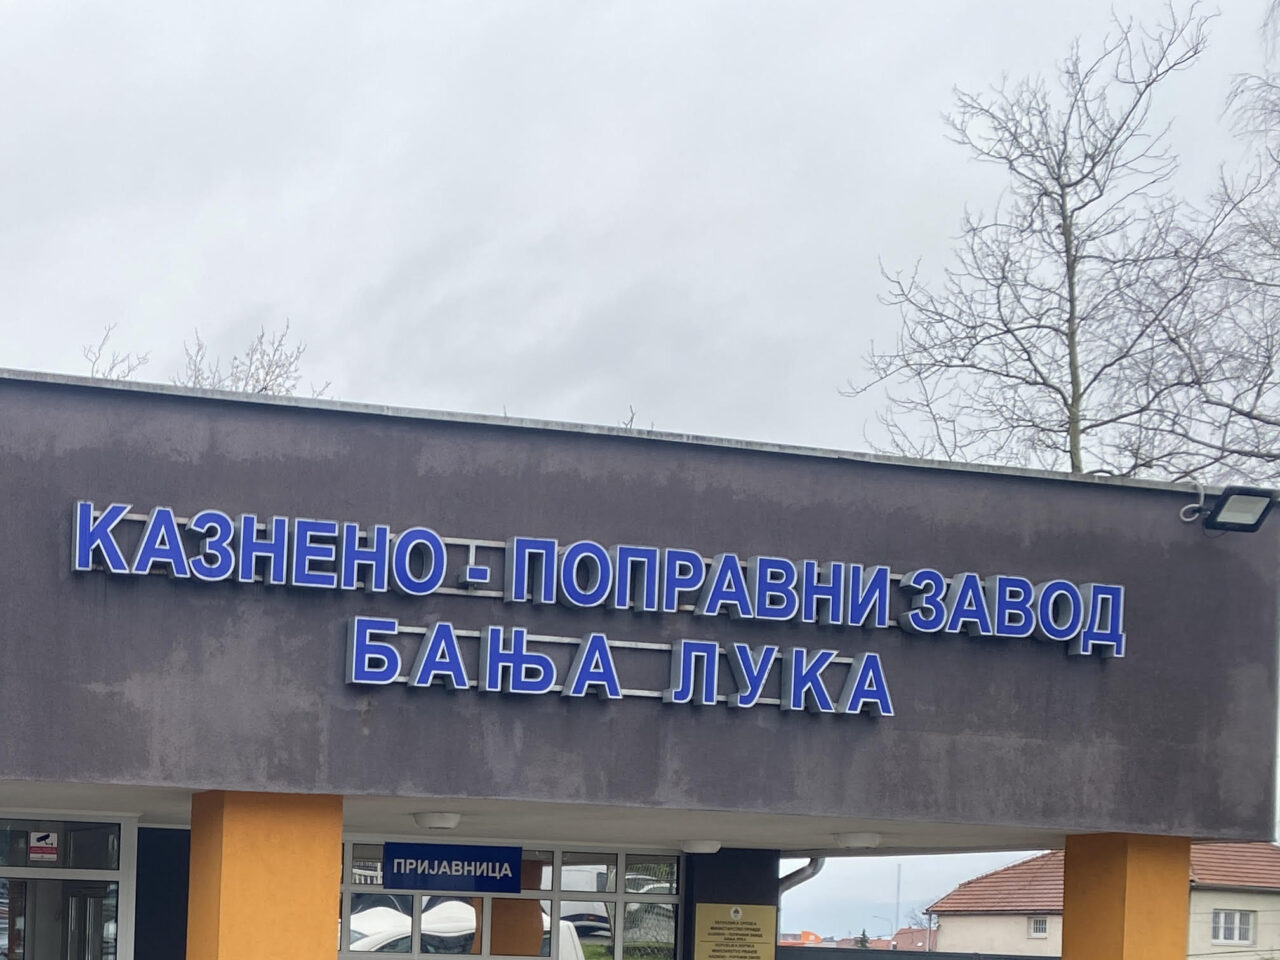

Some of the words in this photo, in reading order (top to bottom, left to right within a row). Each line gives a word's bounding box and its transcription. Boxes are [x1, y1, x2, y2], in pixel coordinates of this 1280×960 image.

[73, 500, 447, 596] КАЗНЕНО
[466, 565, 490, 583] -
[507, 536, 891, 628] ПОПРАВНИ
[902, 568, 1126, 657] ЗАВОД
[349, 615, 623, 699] БАЊА
[669, 638, 895, 717] ЛУКА
[393, 858, 513, 879] ПРИЈАВНИЦА
